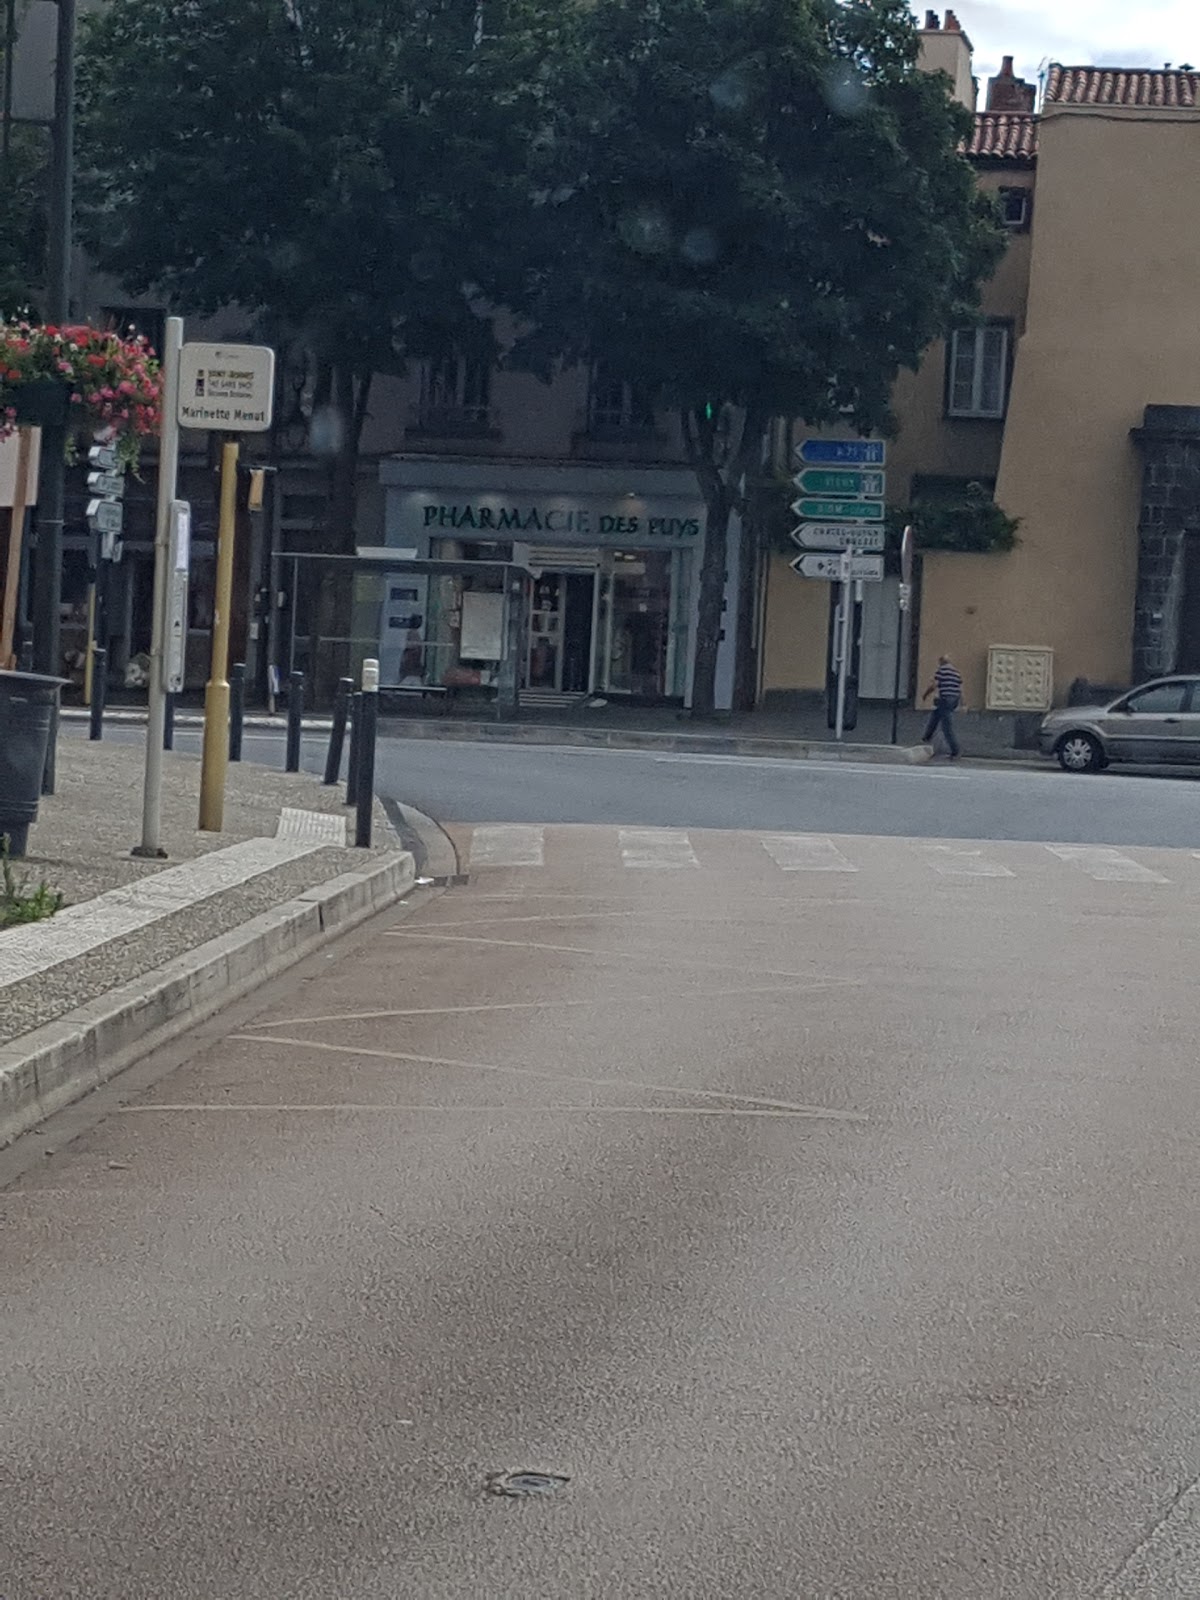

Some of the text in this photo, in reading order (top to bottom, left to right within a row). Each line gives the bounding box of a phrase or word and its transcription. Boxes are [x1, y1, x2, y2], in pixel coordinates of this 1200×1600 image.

[182, 407, 264, 421] Marinette Menut
[423, 505, 699, 537] PHARMACIE DES PUYS
